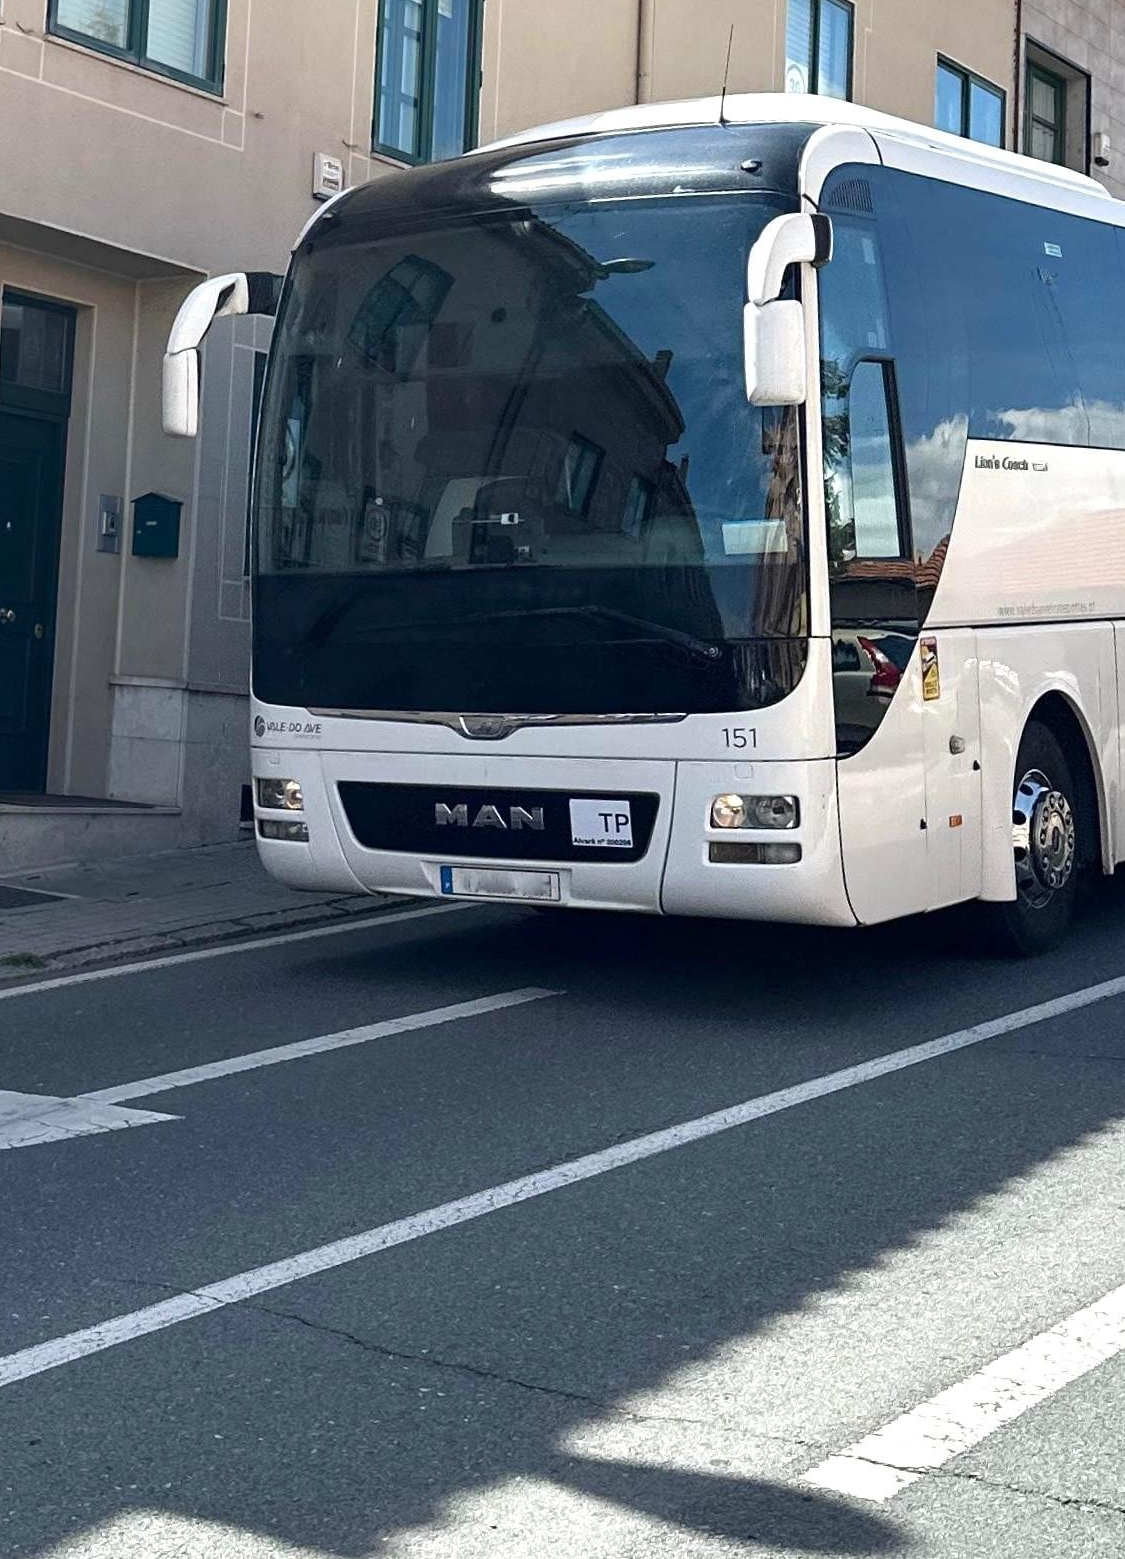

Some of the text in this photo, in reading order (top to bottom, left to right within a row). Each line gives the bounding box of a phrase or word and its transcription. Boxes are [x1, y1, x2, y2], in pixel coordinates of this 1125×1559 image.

[974, 454, 1001, 470] Lion's
[288, 722, 302, 733] DO
[721, 727, 757, 748] 151
[434, 803, 545, 831] MAN
[598, 812, 629, 834] TP
